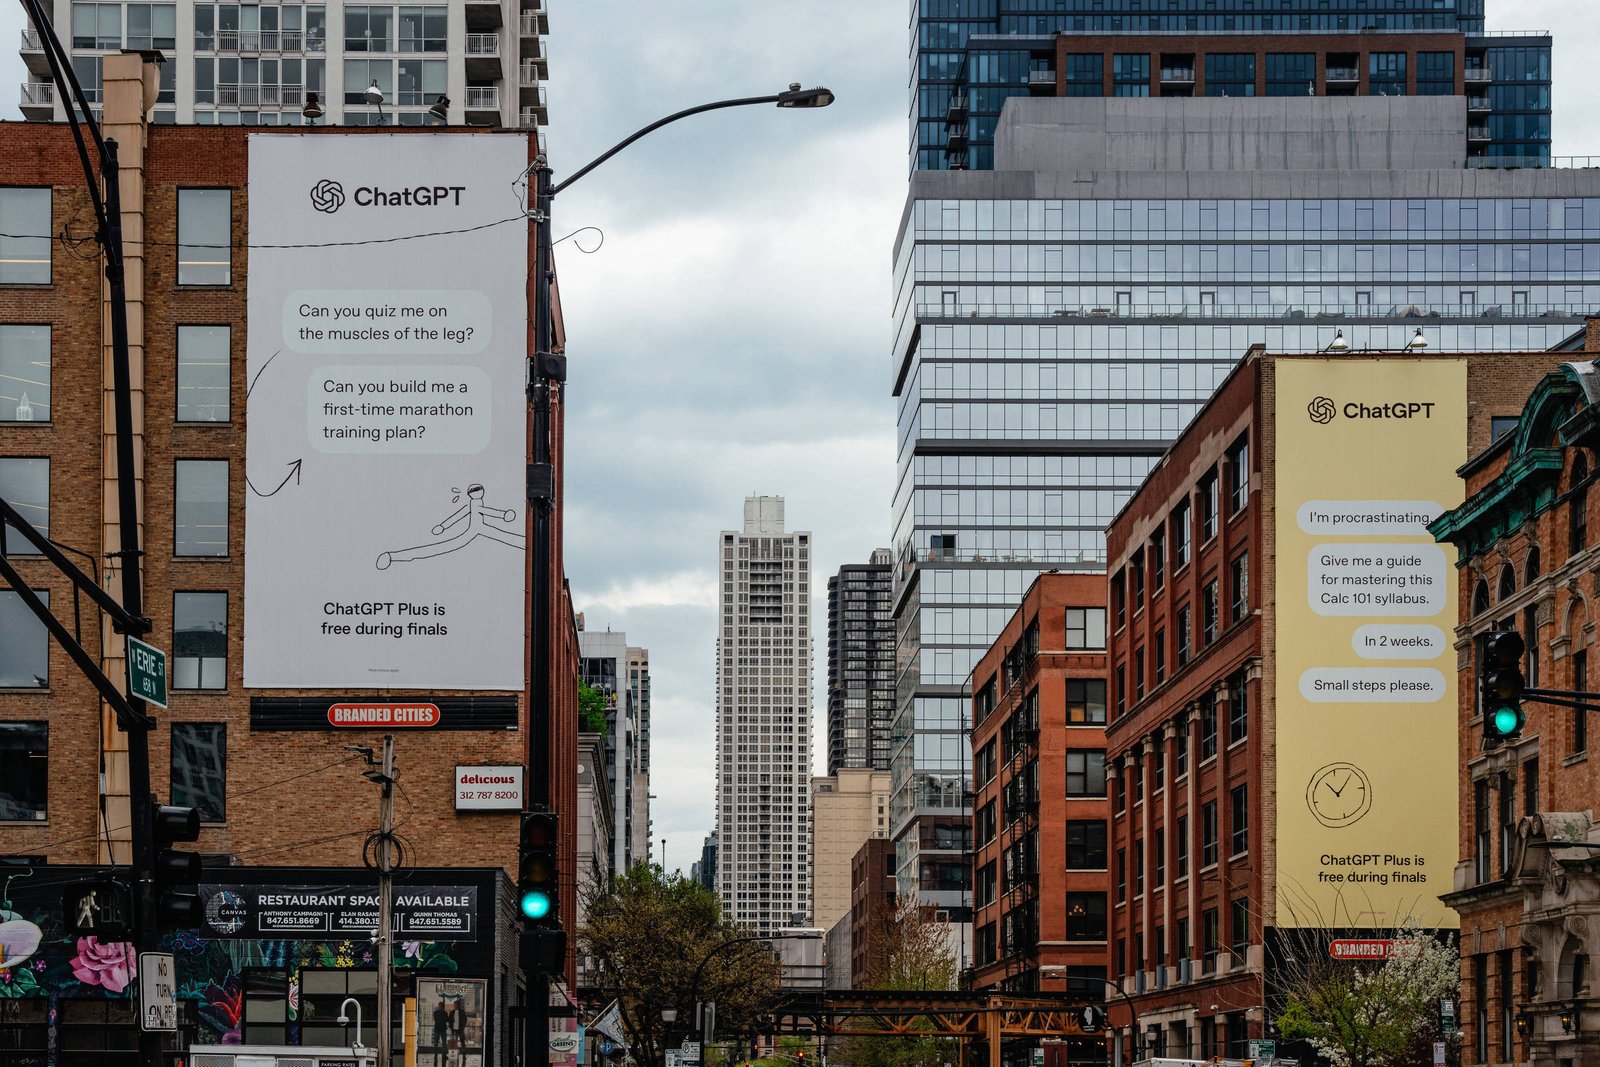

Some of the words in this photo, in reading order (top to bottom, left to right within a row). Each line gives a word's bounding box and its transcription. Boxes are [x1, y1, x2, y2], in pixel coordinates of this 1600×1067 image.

[354, 186, 467, 207] ChatGPT
[299, 304, 330, 318] Can
[333, 307, 361, 321] you
[364, 304, 397, 321] quiz
[401, 307, 425, 318] me
[428, 307, 448, 318] on
[298, 327, 324, 340] the
[328, 327, 390, 340] muscles
[394, 327, 411, 340] of
[413, 327, 439, 340] the
[443, 327, 475, 343] leg?
[323, 379, 354, 393] Can
[357, 382, 385, 396] you
[389, 379, 427, 393] build
[431, 382, 455, 393] me
[458, 383, 468, 393] a
[323, 403, 395, 416] first-time
[399, 403, 473, 416] marathon
[1343, 402, 1436, 419] ChatGPT
[323, 425, 381, 441] training
[385, 425, 426, 441] plan?
[1310, 512, 1330, 523] I'm
[1321, 555, 1349, 566] Give
[1352, 557, 1373, 566] me
[1375, 557, 1383, 566] a
[1386, 555, 1422, 569] guide
[1321, 574, 1338, 585] for
[1342, 574, 1406, 587] mastering
[1409, 574, 1433, 585] this
[1321, 593, 1349, 604] Calc
[1353, 593, 1371, 604] 101
[1375, 593, 1430, 606] syllabus.
[323, 602, 394, 616] ChatGPT
[398, 602, 430, 616] Plus
[434, 602, 446, 616] is
[321, 622, 351, 636] free
[355, 622, 403, 638] during
[407, 622, 448, 636] finals
[1365, 636, 1376, 647] In
[1379, 636, 1388, 647] 2
[1390, 636, 1434, 647] weeks.
[136, 648, 157, 676] ERIE
[158, 662, 164, 677] ST
[1314, 679, 1349, 691] Small
[1352, 680, 1387, 693] steps
[1390, 679, 1434, 693] please.
[334, 708, 392, 722] BRANDED
[394, 708, 433, 722] CITIES
[460, 773, 515, 785] delicious
[459, 791, 475, 800] 312
[476, 791, 492, 800] 787
[494, 791, 519, 800] 8200
[1320, 854, 1381, 866] ChatGPT
[1384, 855, 1411, 866] Plus
[1414, 854, 1425, 866] is
[1318, 871, 1344, 883] free
[1347, 871, 1388, 885] during
[1391, 871, 1427, 883] finals
[258, 895, 346, 906] RESTAURANT
[349, 895, 380, 906] SPAC
[396, 896, 470, 907] AVAILABLE
[267, 917, 320, 925] 847.651.8669
[409, 917, 462, 926] 847.651.5589
[158, 963, 168, 976] NO
[156, 983, 172, 998] TURN
[149, 1005, 162, 1019] ON
